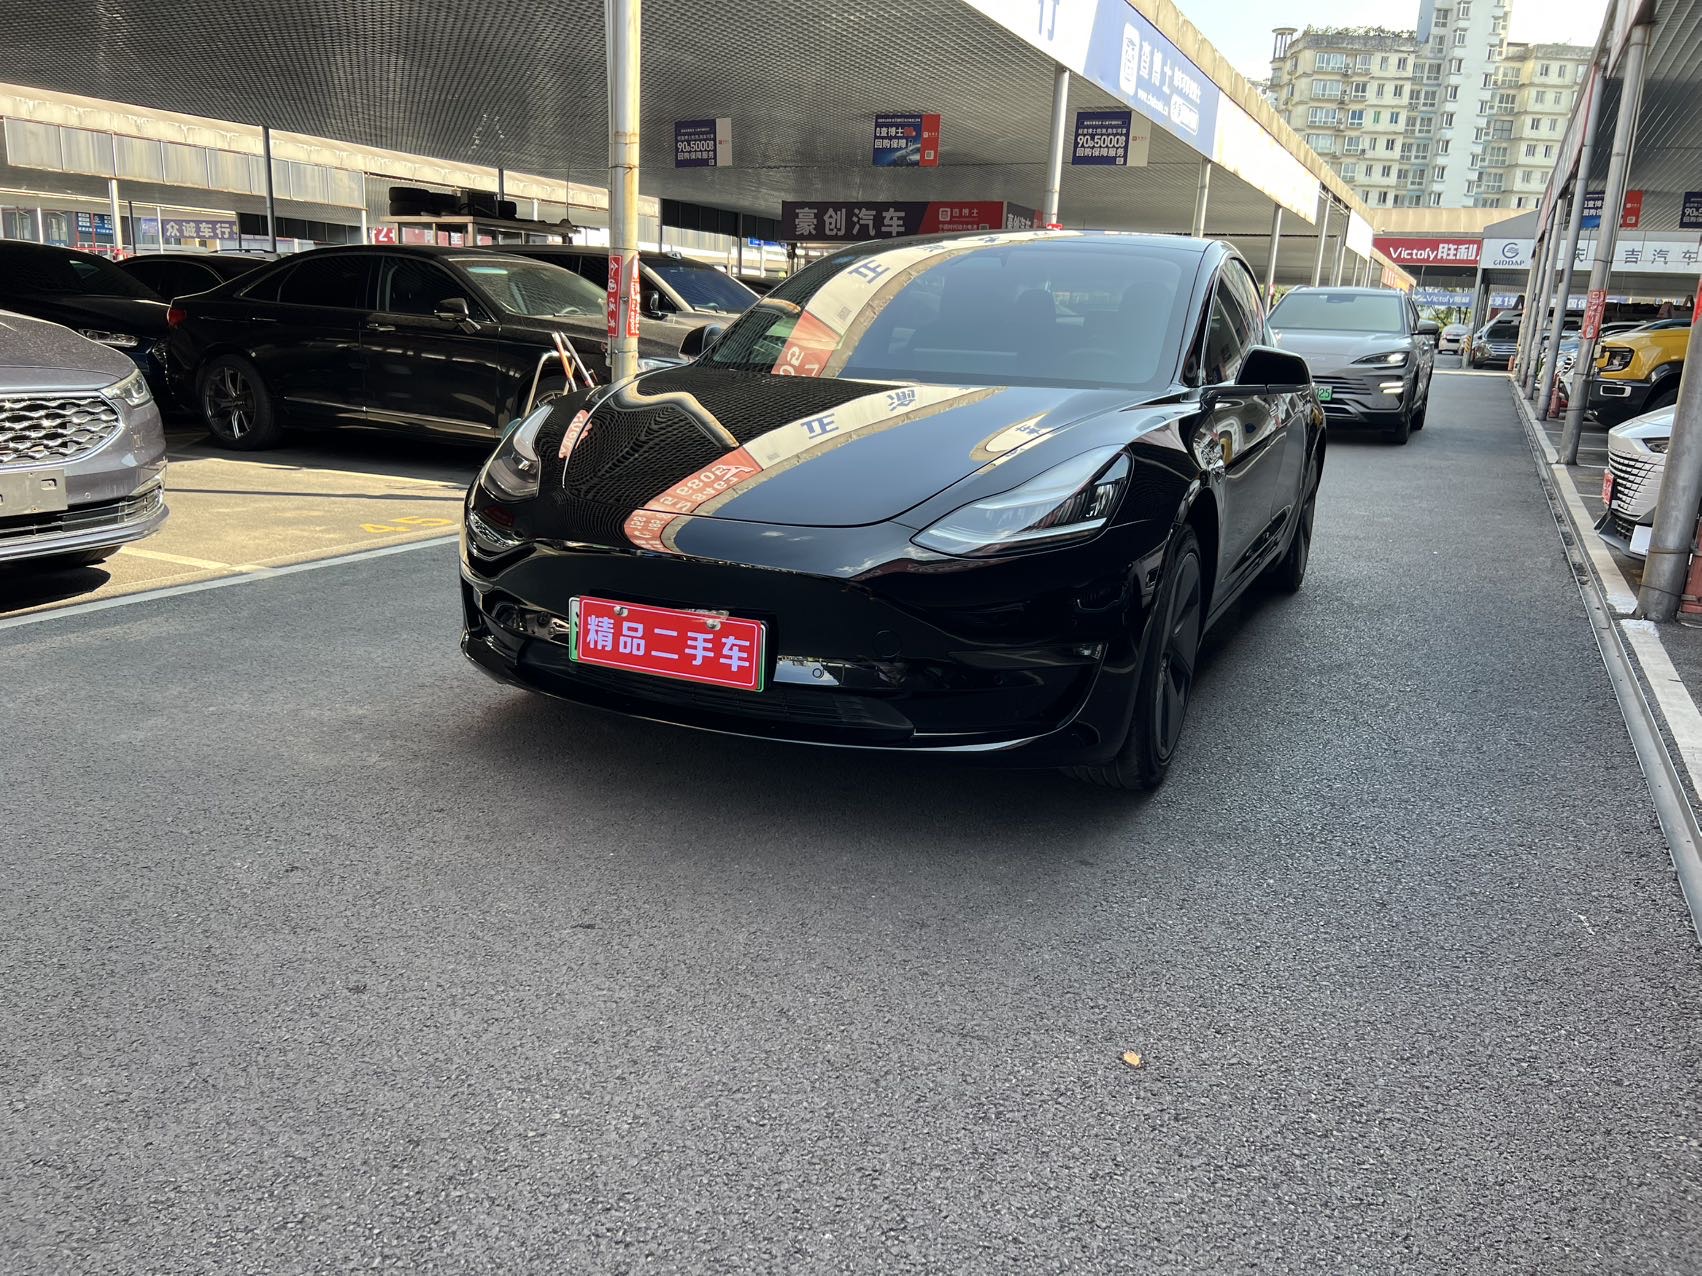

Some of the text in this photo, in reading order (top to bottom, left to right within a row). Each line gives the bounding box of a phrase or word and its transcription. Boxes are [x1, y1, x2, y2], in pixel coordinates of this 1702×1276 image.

[166, 221, 231, 238] 众诚车行
[795, 207, 906, 237] 豪创汽车
[586, 615, 750, 671] 精品二手车
